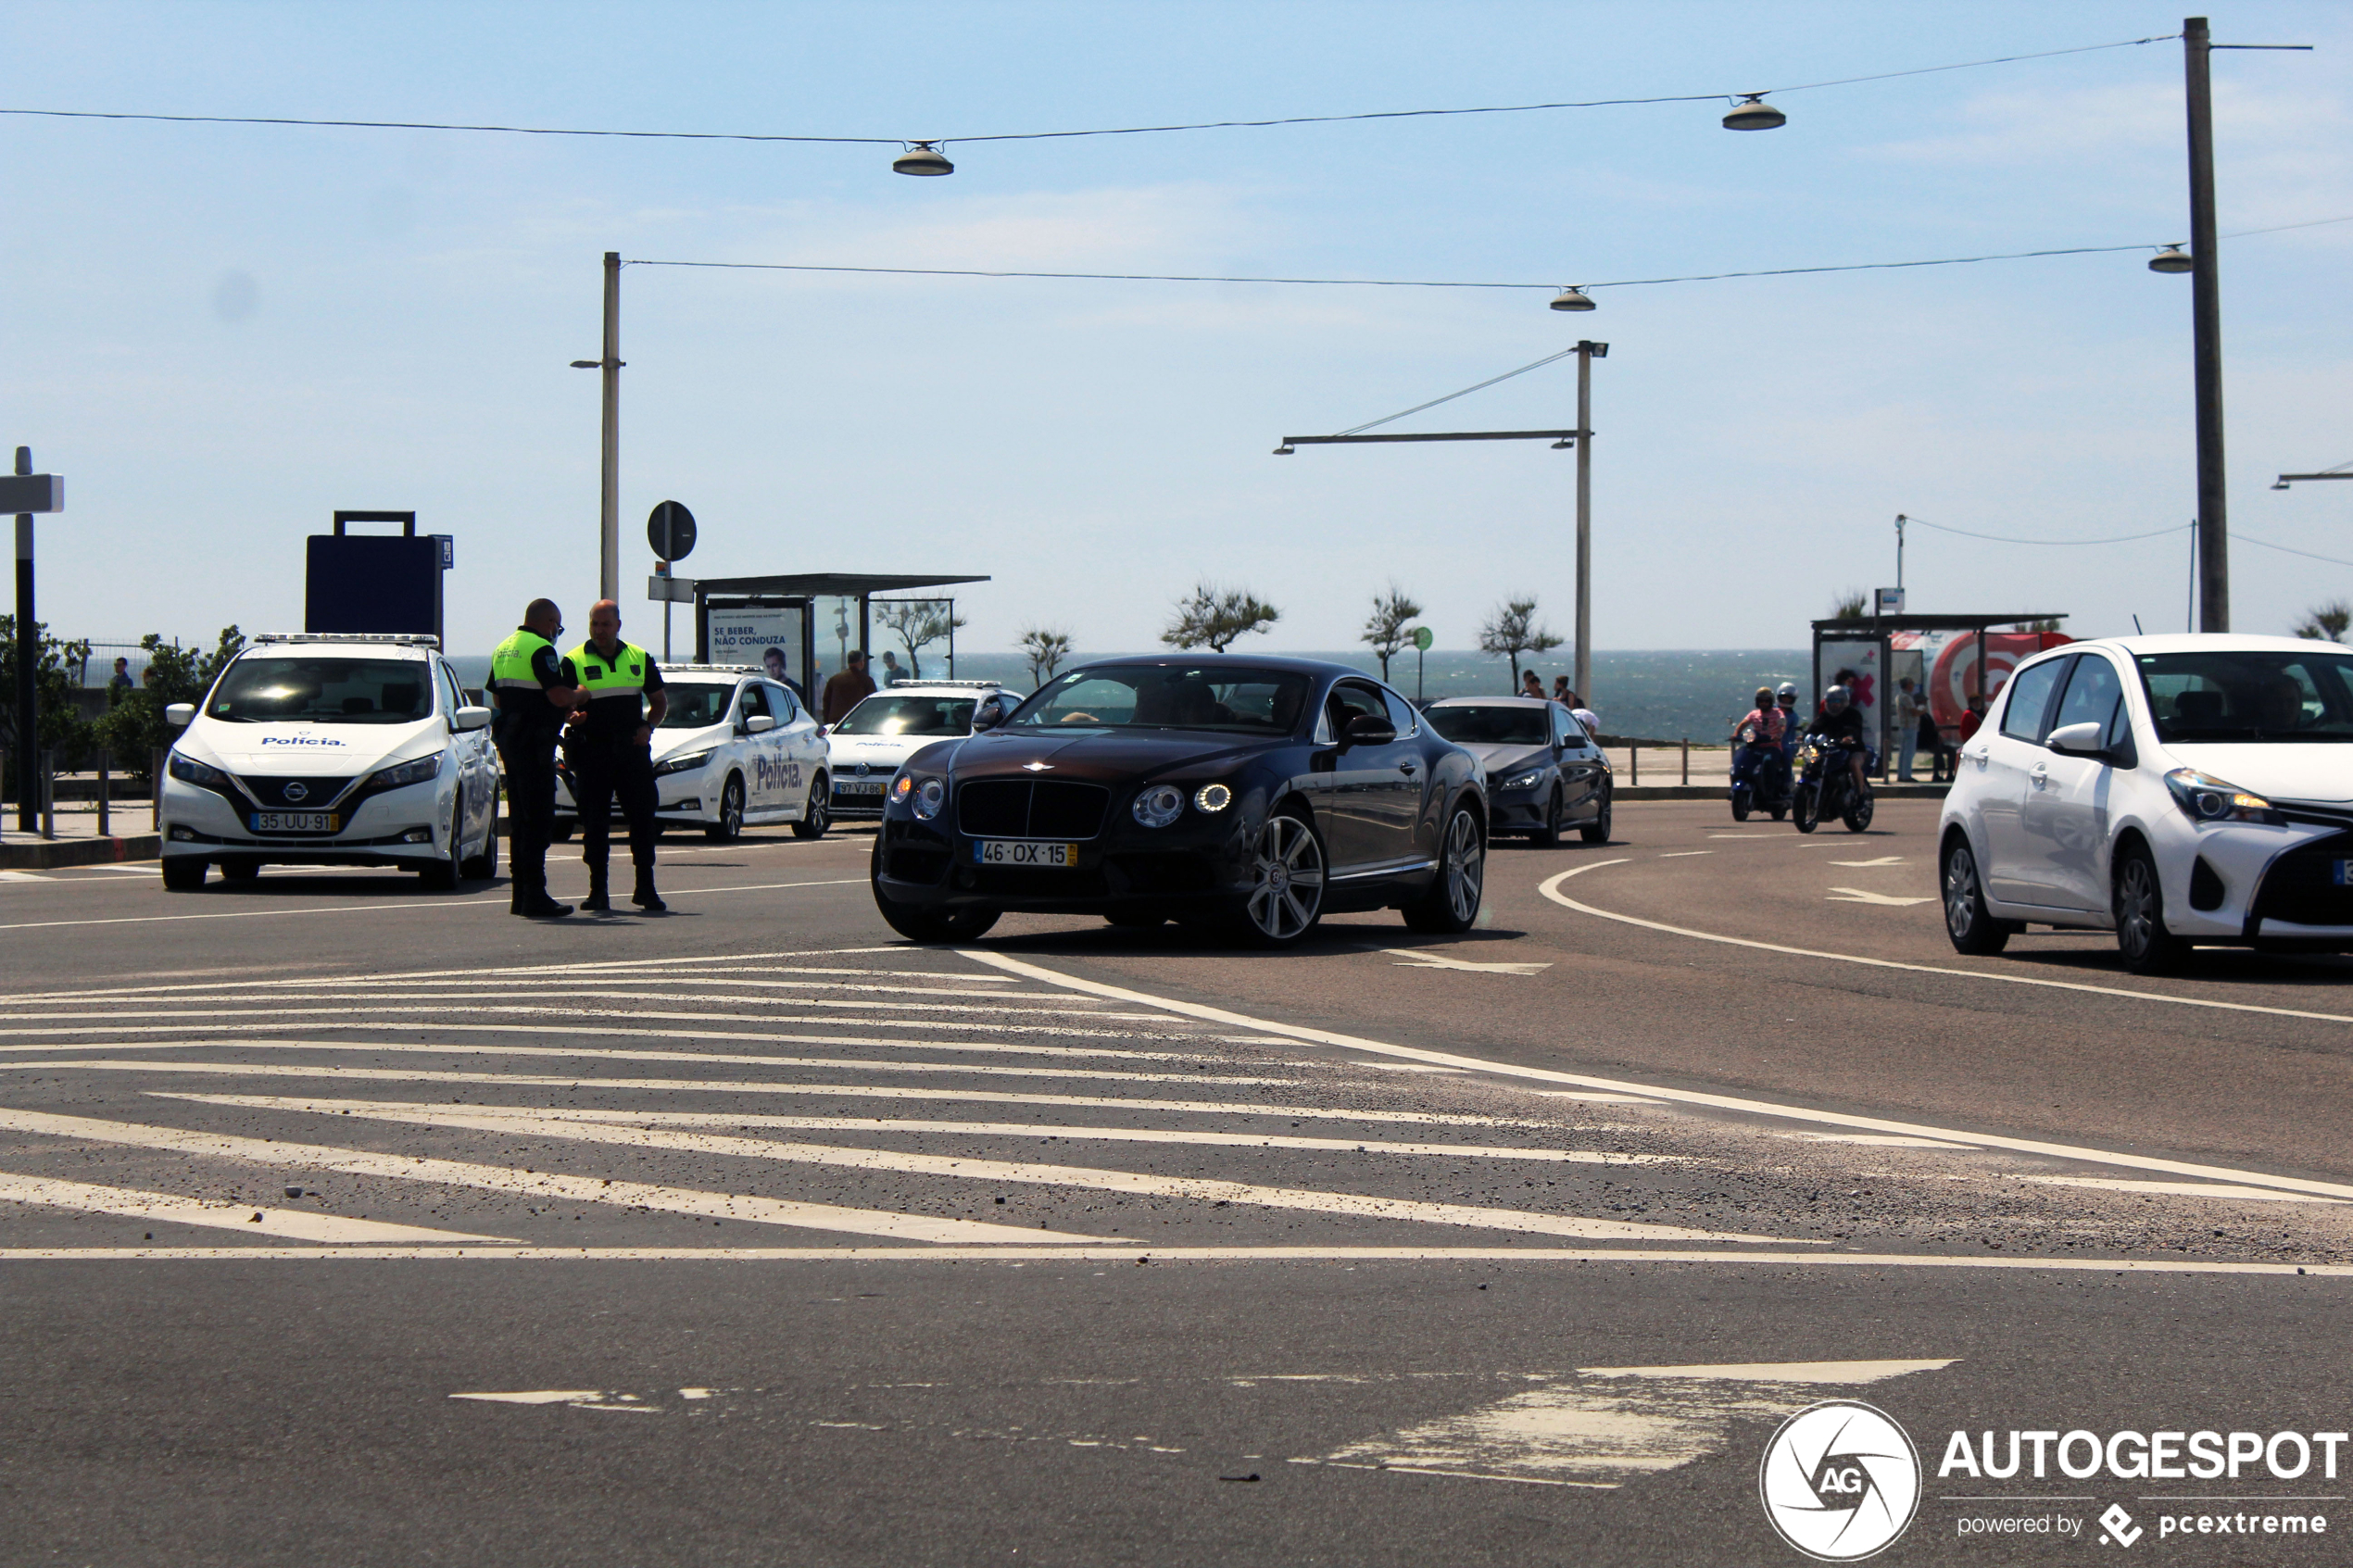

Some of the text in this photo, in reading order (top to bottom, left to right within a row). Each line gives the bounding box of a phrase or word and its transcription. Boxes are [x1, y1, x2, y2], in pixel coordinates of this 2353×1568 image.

[714, 626, 758, 636] SE BEBER,
[714, 635, 786, 646] NÃO CONDUZA
[261, 737, 346, 746] Polícia.
[757, 753, 802, 791] Polícia.
